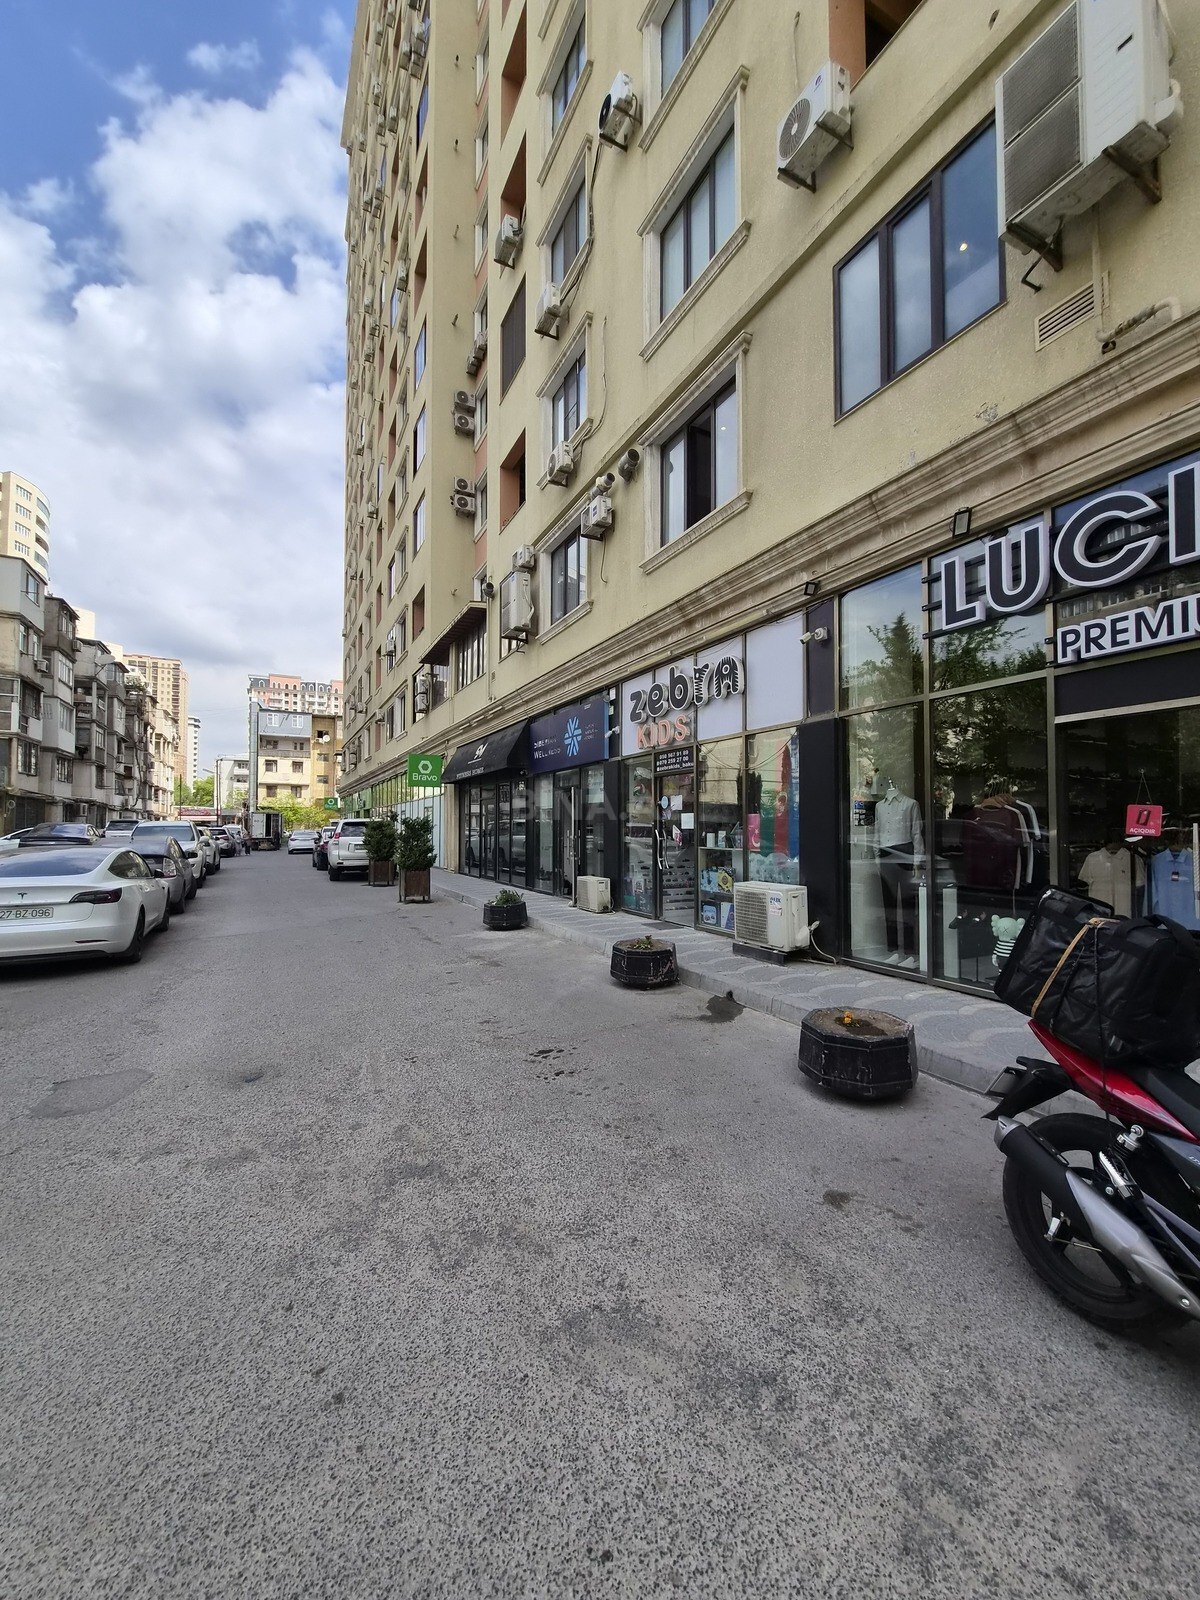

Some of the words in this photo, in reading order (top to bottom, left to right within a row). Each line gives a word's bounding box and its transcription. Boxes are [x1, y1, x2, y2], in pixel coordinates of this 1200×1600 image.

[1057, 592, 1200, 664] PREMI
[637, 714, 690, 750] KIDS
[412, 772, 438, 782] Bravo
